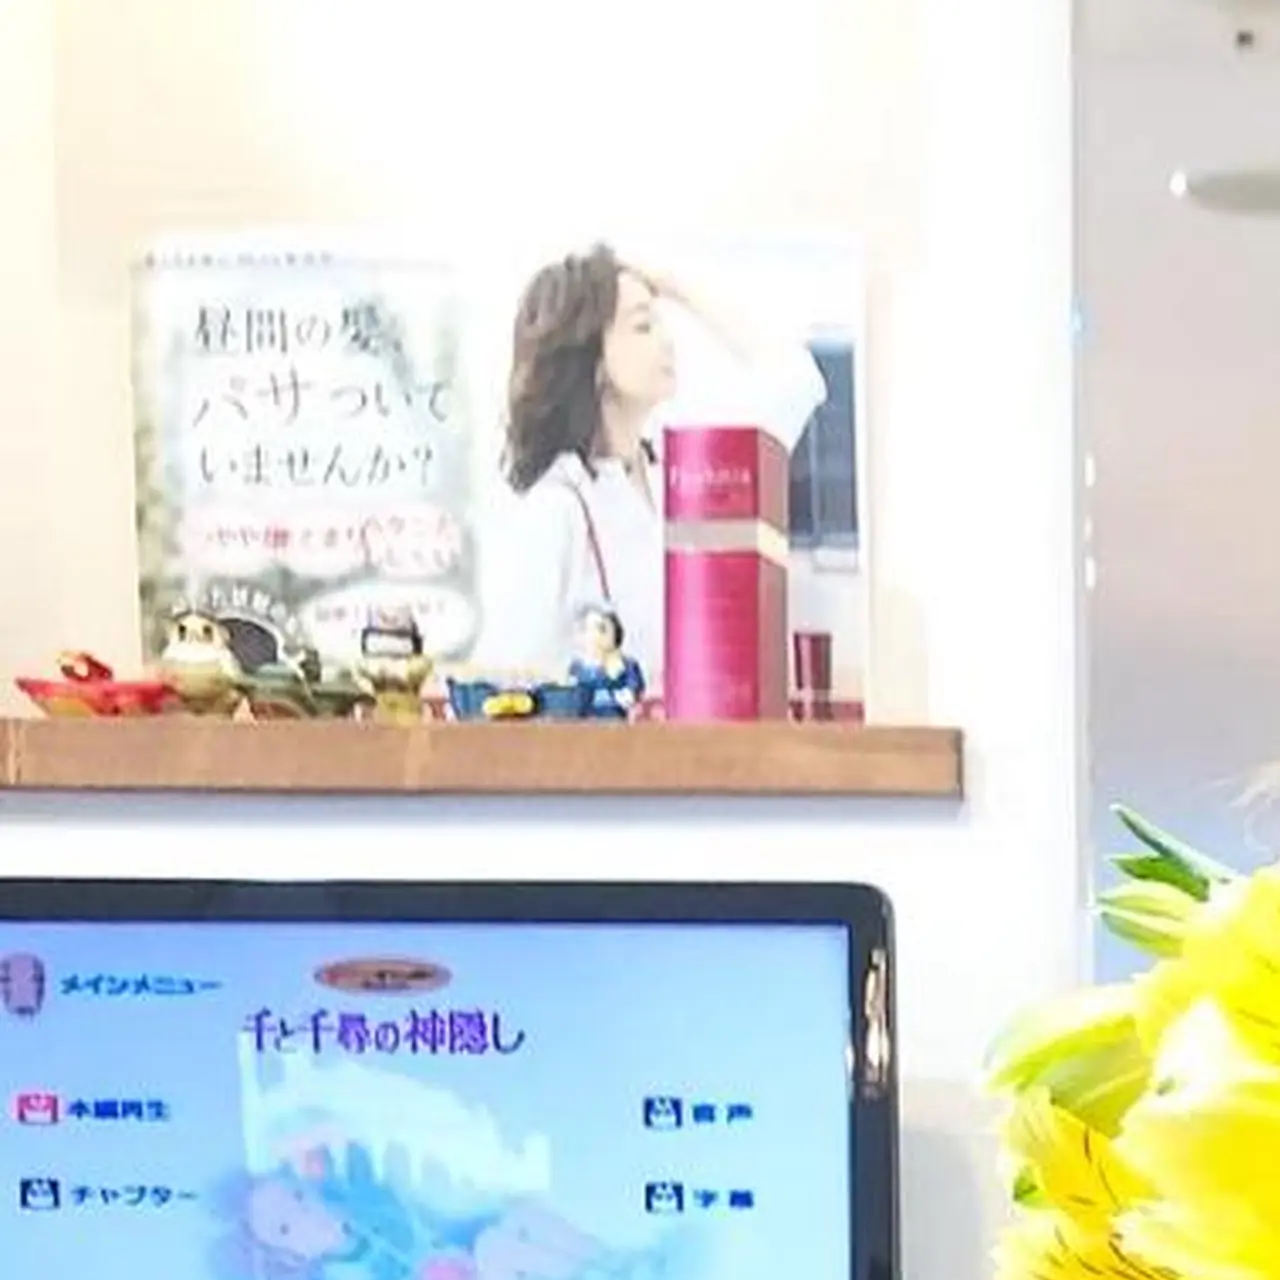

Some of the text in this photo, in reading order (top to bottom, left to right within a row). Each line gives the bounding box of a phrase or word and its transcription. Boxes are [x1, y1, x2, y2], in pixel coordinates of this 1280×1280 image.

[60, 972, 223, 996] メインメニュー
[242, 1004, 526, 1055] 千と千尋の神隠し
[71, 1185, 198, 1206] チャプター
